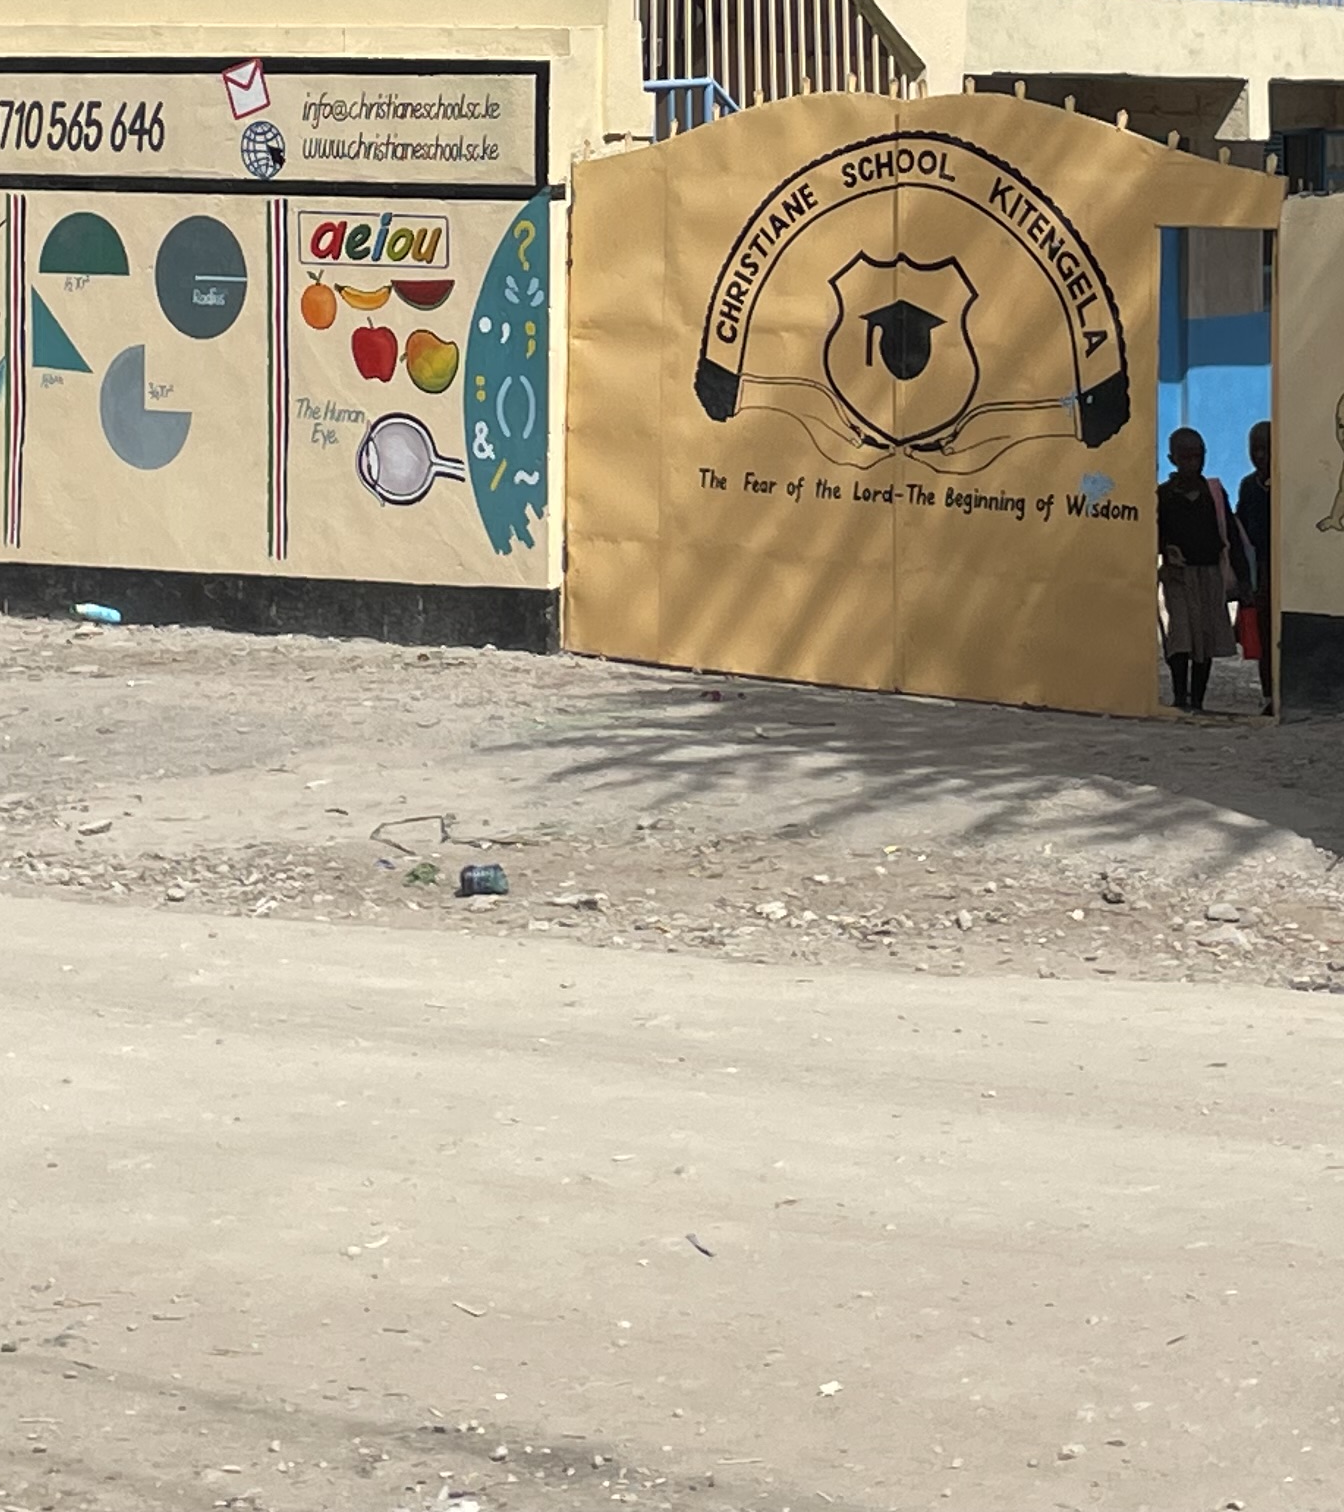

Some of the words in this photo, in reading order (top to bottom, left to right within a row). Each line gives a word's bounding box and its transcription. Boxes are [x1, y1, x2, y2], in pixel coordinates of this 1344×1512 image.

[48, 100, 103, 151] 565
[110, 100, 165, 152] 646
[310, 212, 442, 264] aeiou
[716, 184, 818, 344] CHRISTIANE
[842, 149, 956, 188] SCHOOL
[988, 177, 1108, 359] KITENGELA
[296, 398, 324, 420] The
[324, 401, 366, 424] Human
[699, 467, 727, 491] The
[744, 471, 777, 494] Fear
[786, 476, 805, 503] of
[815, 478, 842, 500] the
[945, 486, 1026, 521] Beginning
[1036, 494, 1055, 522] of
